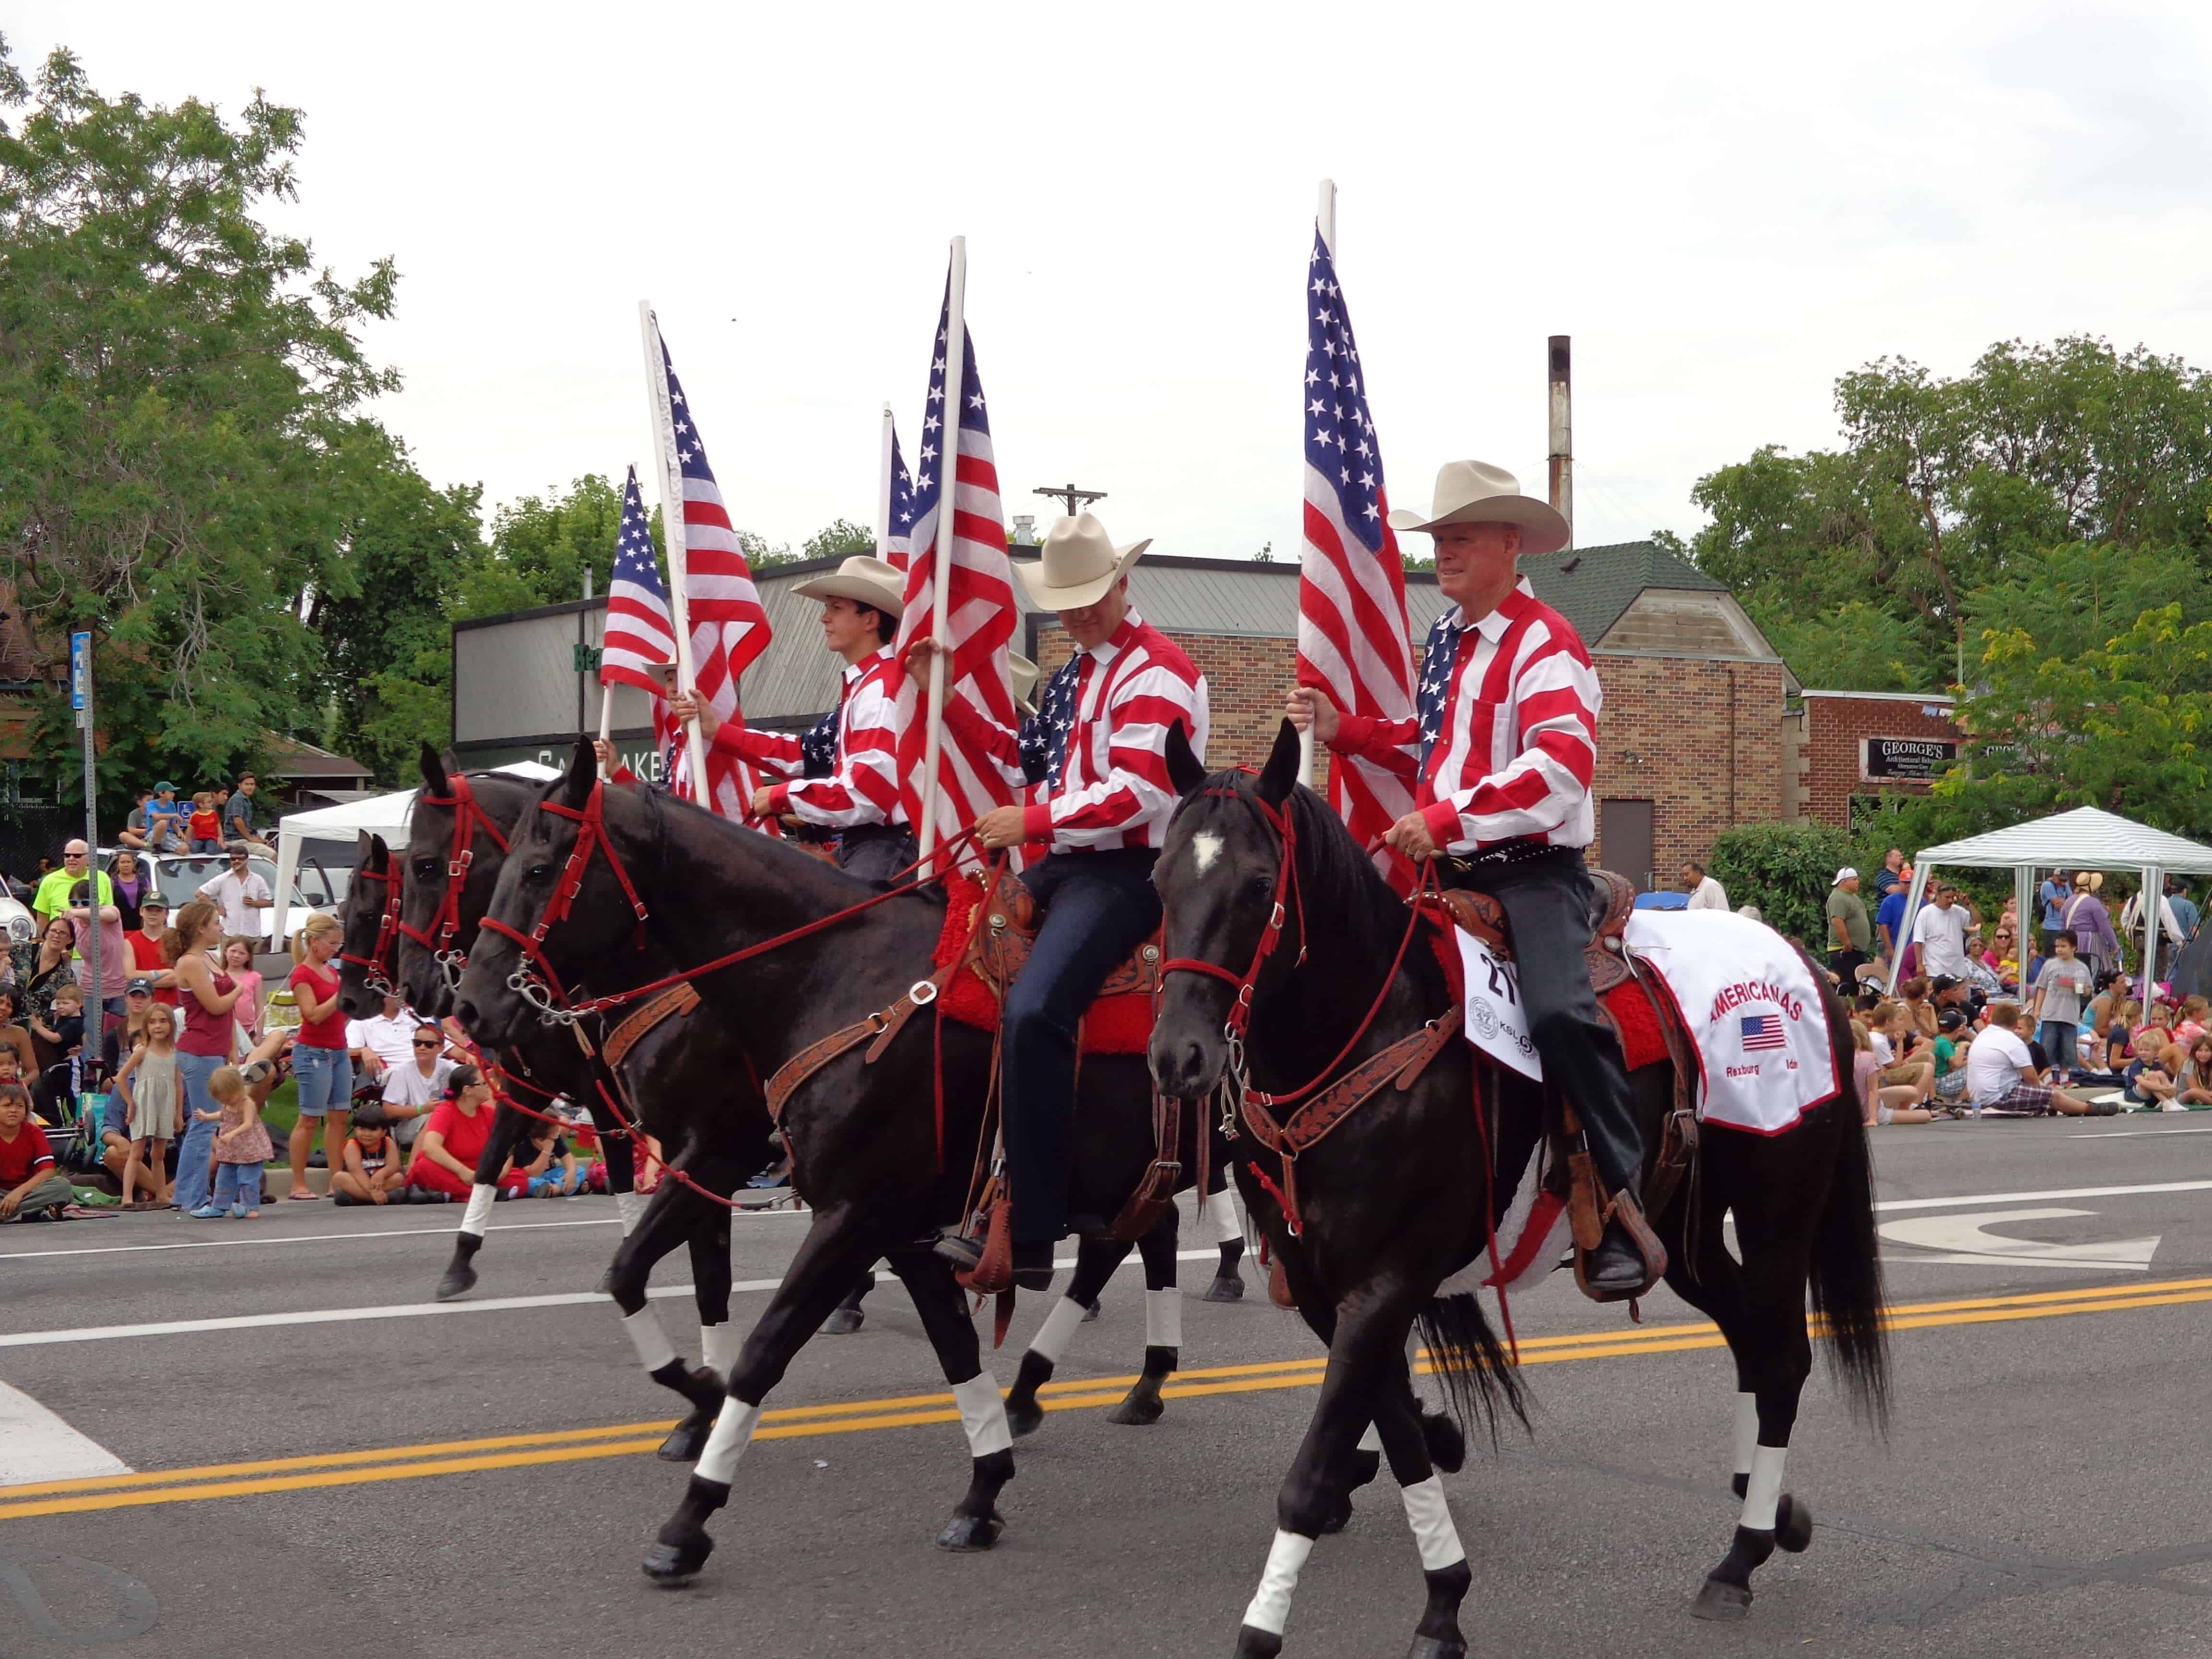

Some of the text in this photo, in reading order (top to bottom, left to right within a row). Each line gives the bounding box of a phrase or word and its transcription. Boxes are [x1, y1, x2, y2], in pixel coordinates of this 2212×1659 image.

[1882, 741, 1943, 759] GEORGE'S
[603, 752, 661, 784] AKE
[1710, 981, 1802, 1022] AMERICANAS
[1726, 1064, 1760, 1077] Rexburg
